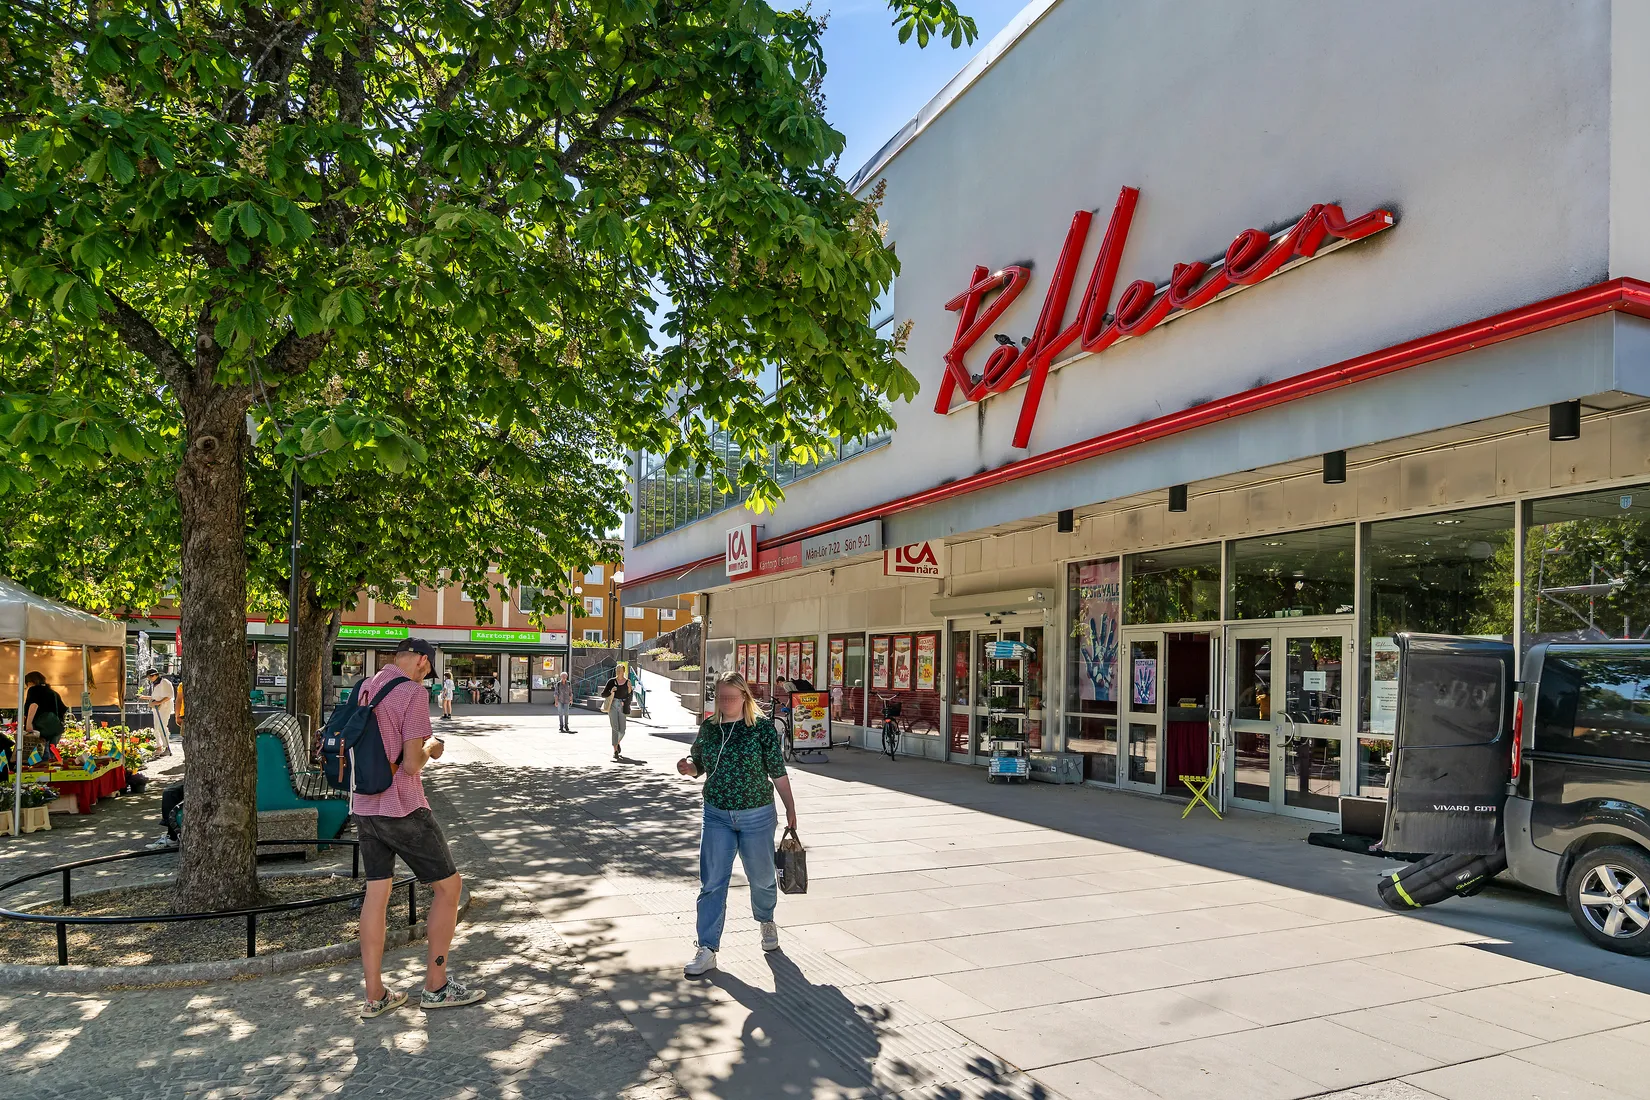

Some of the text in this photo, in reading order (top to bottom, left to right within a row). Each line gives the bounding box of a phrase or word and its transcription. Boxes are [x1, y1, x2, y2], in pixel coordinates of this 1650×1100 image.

[729, 530, 748, 561] ICA
[805, 534, 871, 561] Mån-Lör 7-22 Sön 9-21
[896, 541, 938, 565] ICA
[738, 560, 749, 569] nära
[777, 553, 799, 567] Centrum
[916, 564, 939, 575] nära
[339, 627, 403, 637] Kärrtorps deli
[476, 632, 536, 642] Kärrtorps deli
